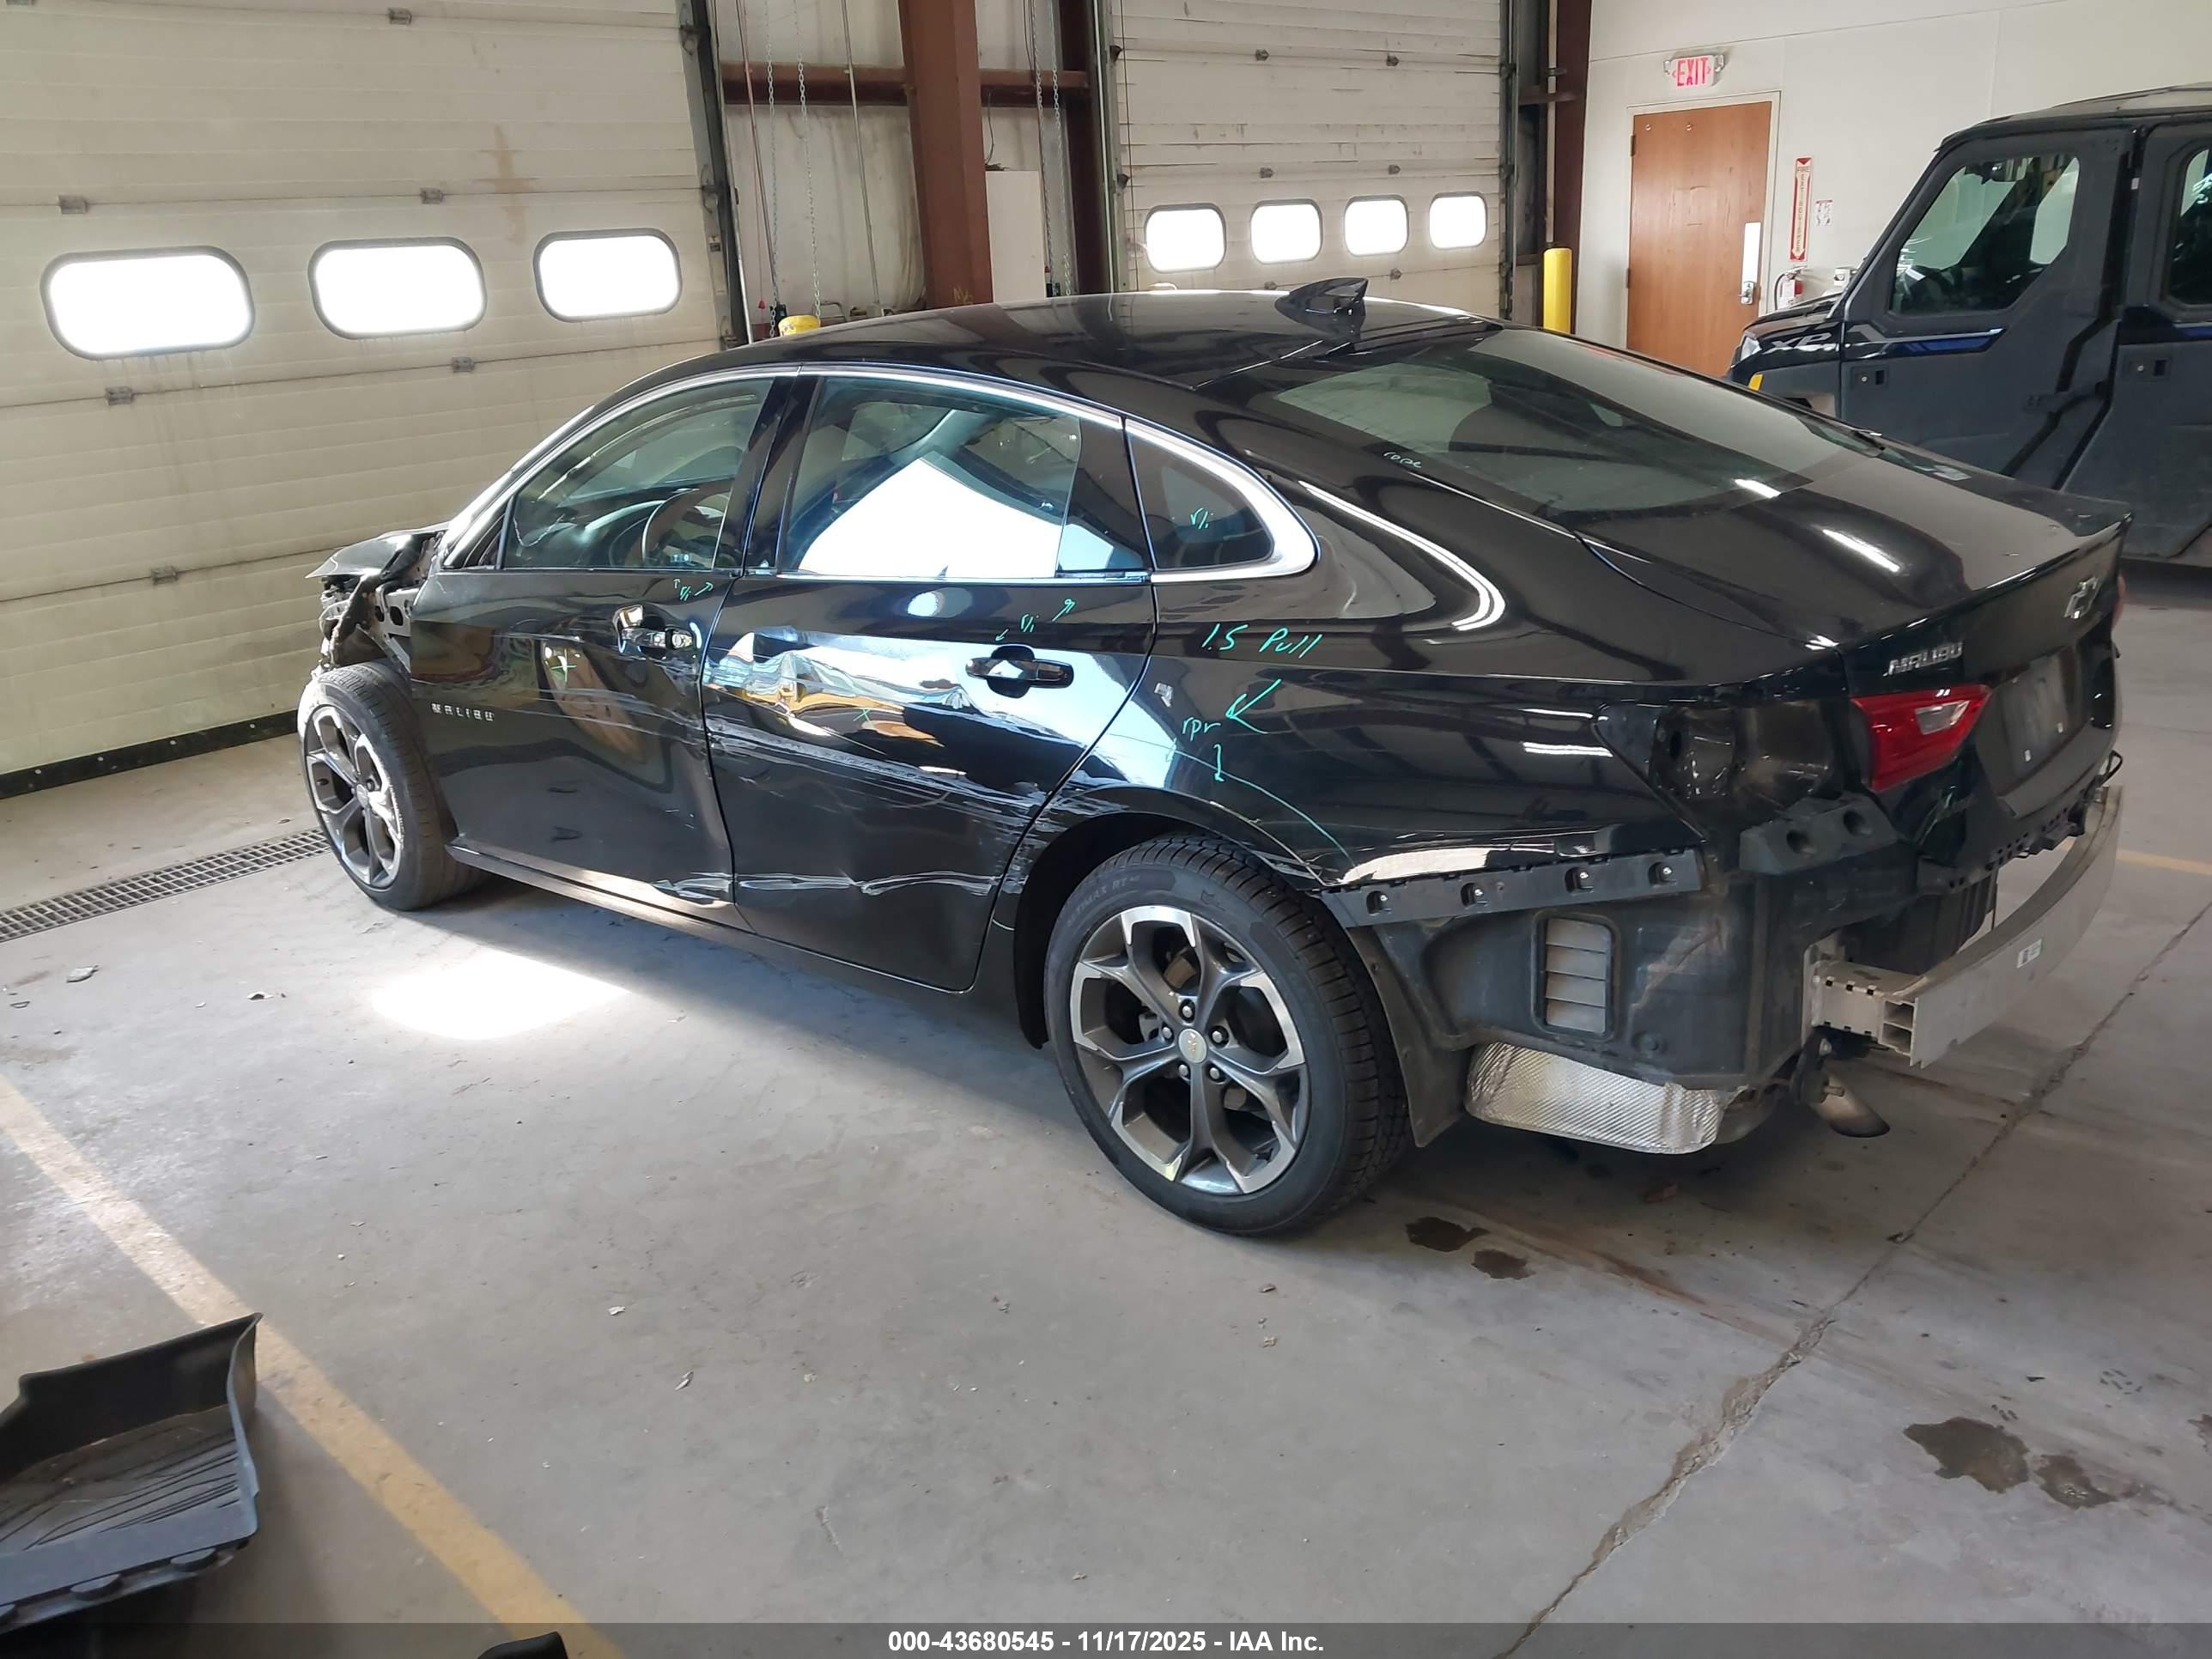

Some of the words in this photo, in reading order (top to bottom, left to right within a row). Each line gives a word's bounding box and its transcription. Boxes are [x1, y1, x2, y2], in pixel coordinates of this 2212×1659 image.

[1677, 57, 1709, 87] EXIT
[1259, 628, 1323, 659] Pull
[431, 702, 495, 722] MALIBU
